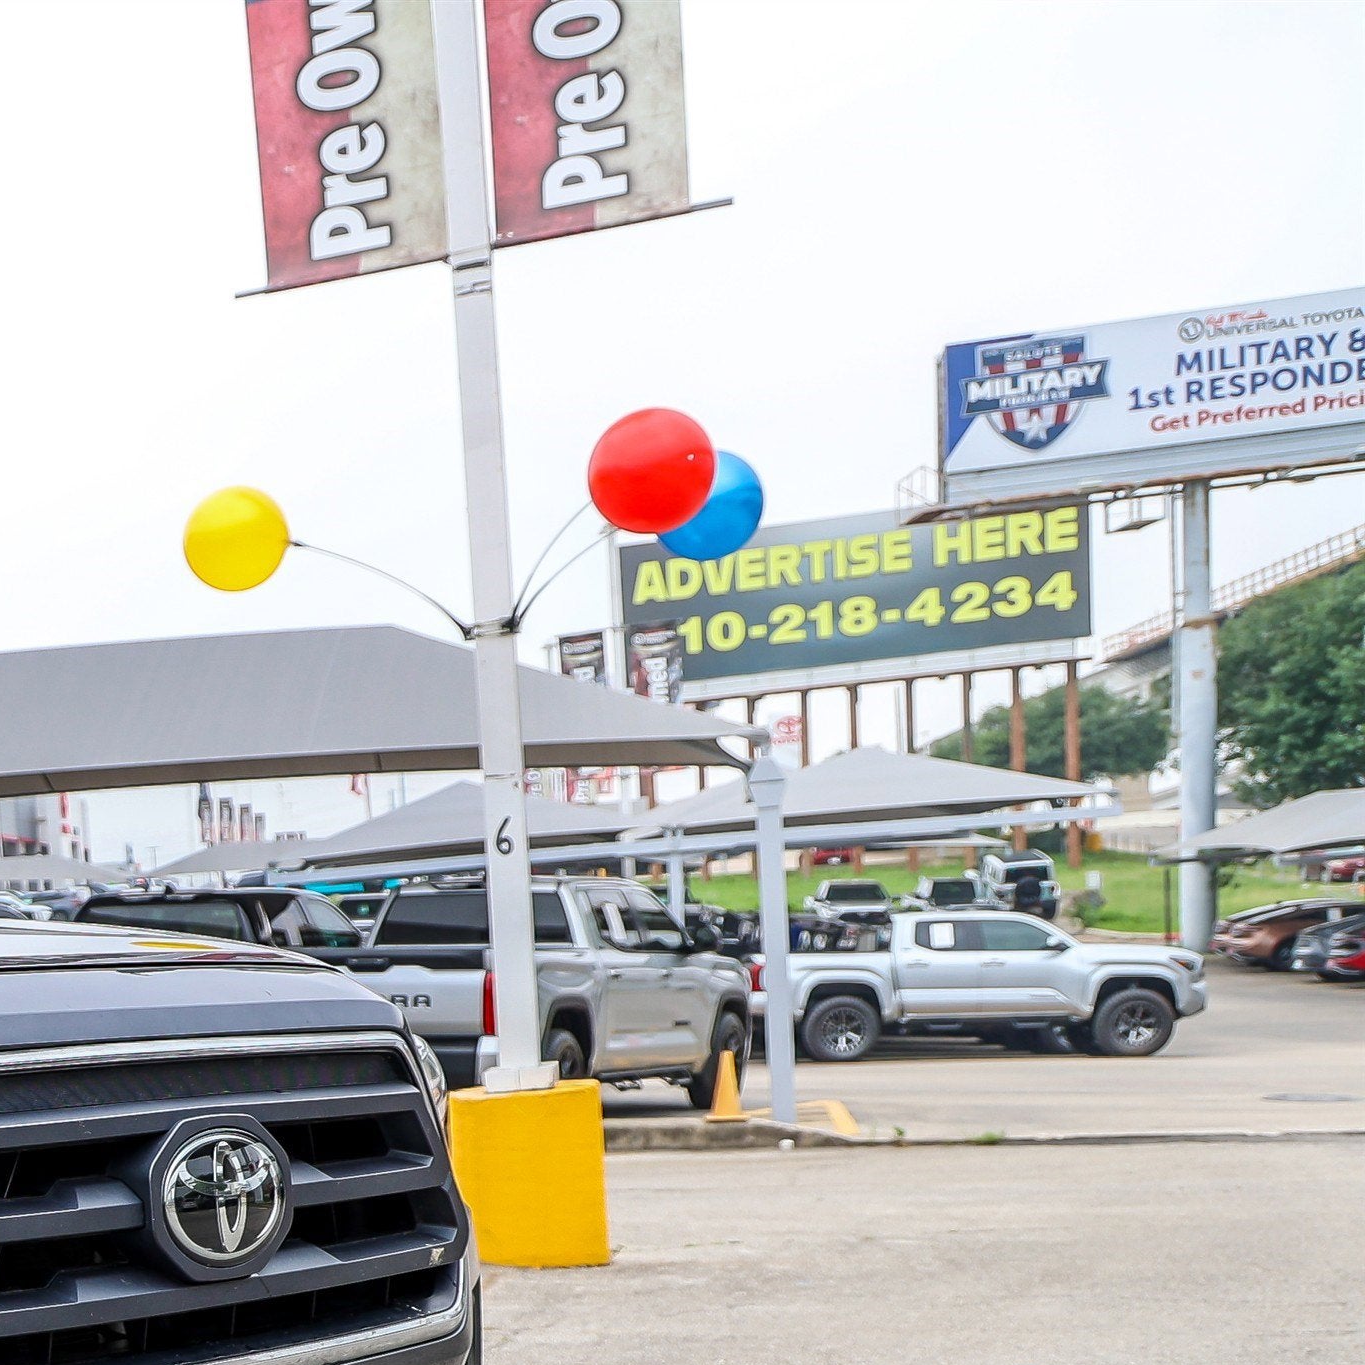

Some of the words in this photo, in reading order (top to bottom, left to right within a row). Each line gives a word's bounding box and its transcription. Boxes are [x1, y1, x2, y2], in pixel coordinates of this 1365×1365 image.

[540, 70, 629, 210] Pre
[309, 121, 391, 261] Pre
[1205, 316, 1298, 340] UNIVERSAL
[1301, 307, 1364, 326] TOYOTA
[1175, 331, 1338, 376] MILITARY
[967, 363, 1103, 403] MILITARY
[1128, 385, 1174, 410] 1st
[1150, 414, 1190, 433] Get
[1198, 397, 1305, 426] Preferred
[631, 528, 914, 606] ADVERTISE
[931, 506, 1080, 569] HERE
[675, 570, 1079, 656] 10-218-4234
[496, 815, 514, 855] 6
[390, 994, 432, 1008] RA
